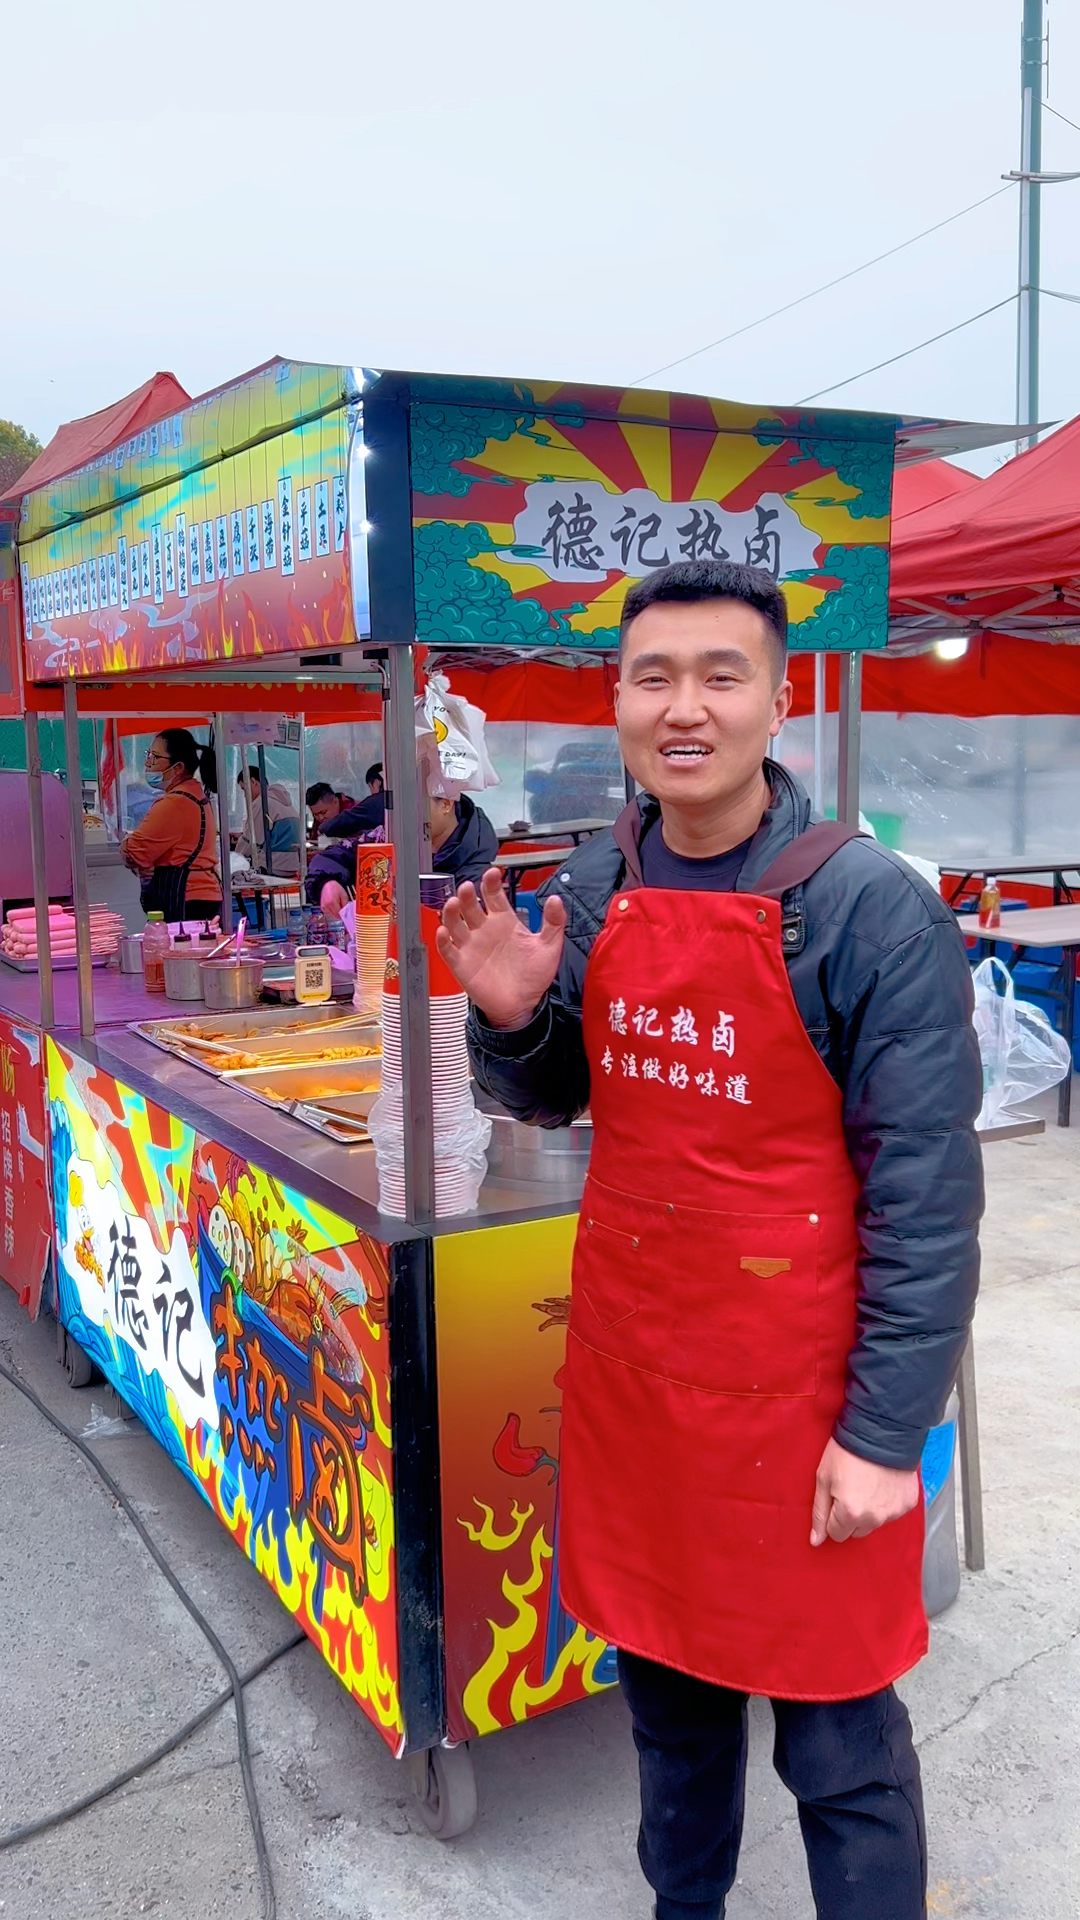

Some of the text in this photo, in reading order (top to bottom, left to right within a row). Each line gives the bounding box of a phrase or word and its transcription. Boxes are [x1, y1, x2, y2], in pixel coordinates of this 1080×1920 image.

[233, 521, 241, 566] 腐竹
[249, 517, 259, 562] 千张
[264, 512, 274, 560] 海带
[282, 495, 292, 567] 金针菇
[300, 501, 310, 550] 平菇
[318, 499, 327, 549] 土豆
[541, 492, 781, 579] 德记热卤
[166, 542, 173, 584] 百叶
[205, 531, 213, 574] 素鸡
[608, 997, 735, 1058] 德记热卤
[601, 1045, 752, 1105] 专注做好味道
[1, 1107, 15, 1258] 招牌香辣
